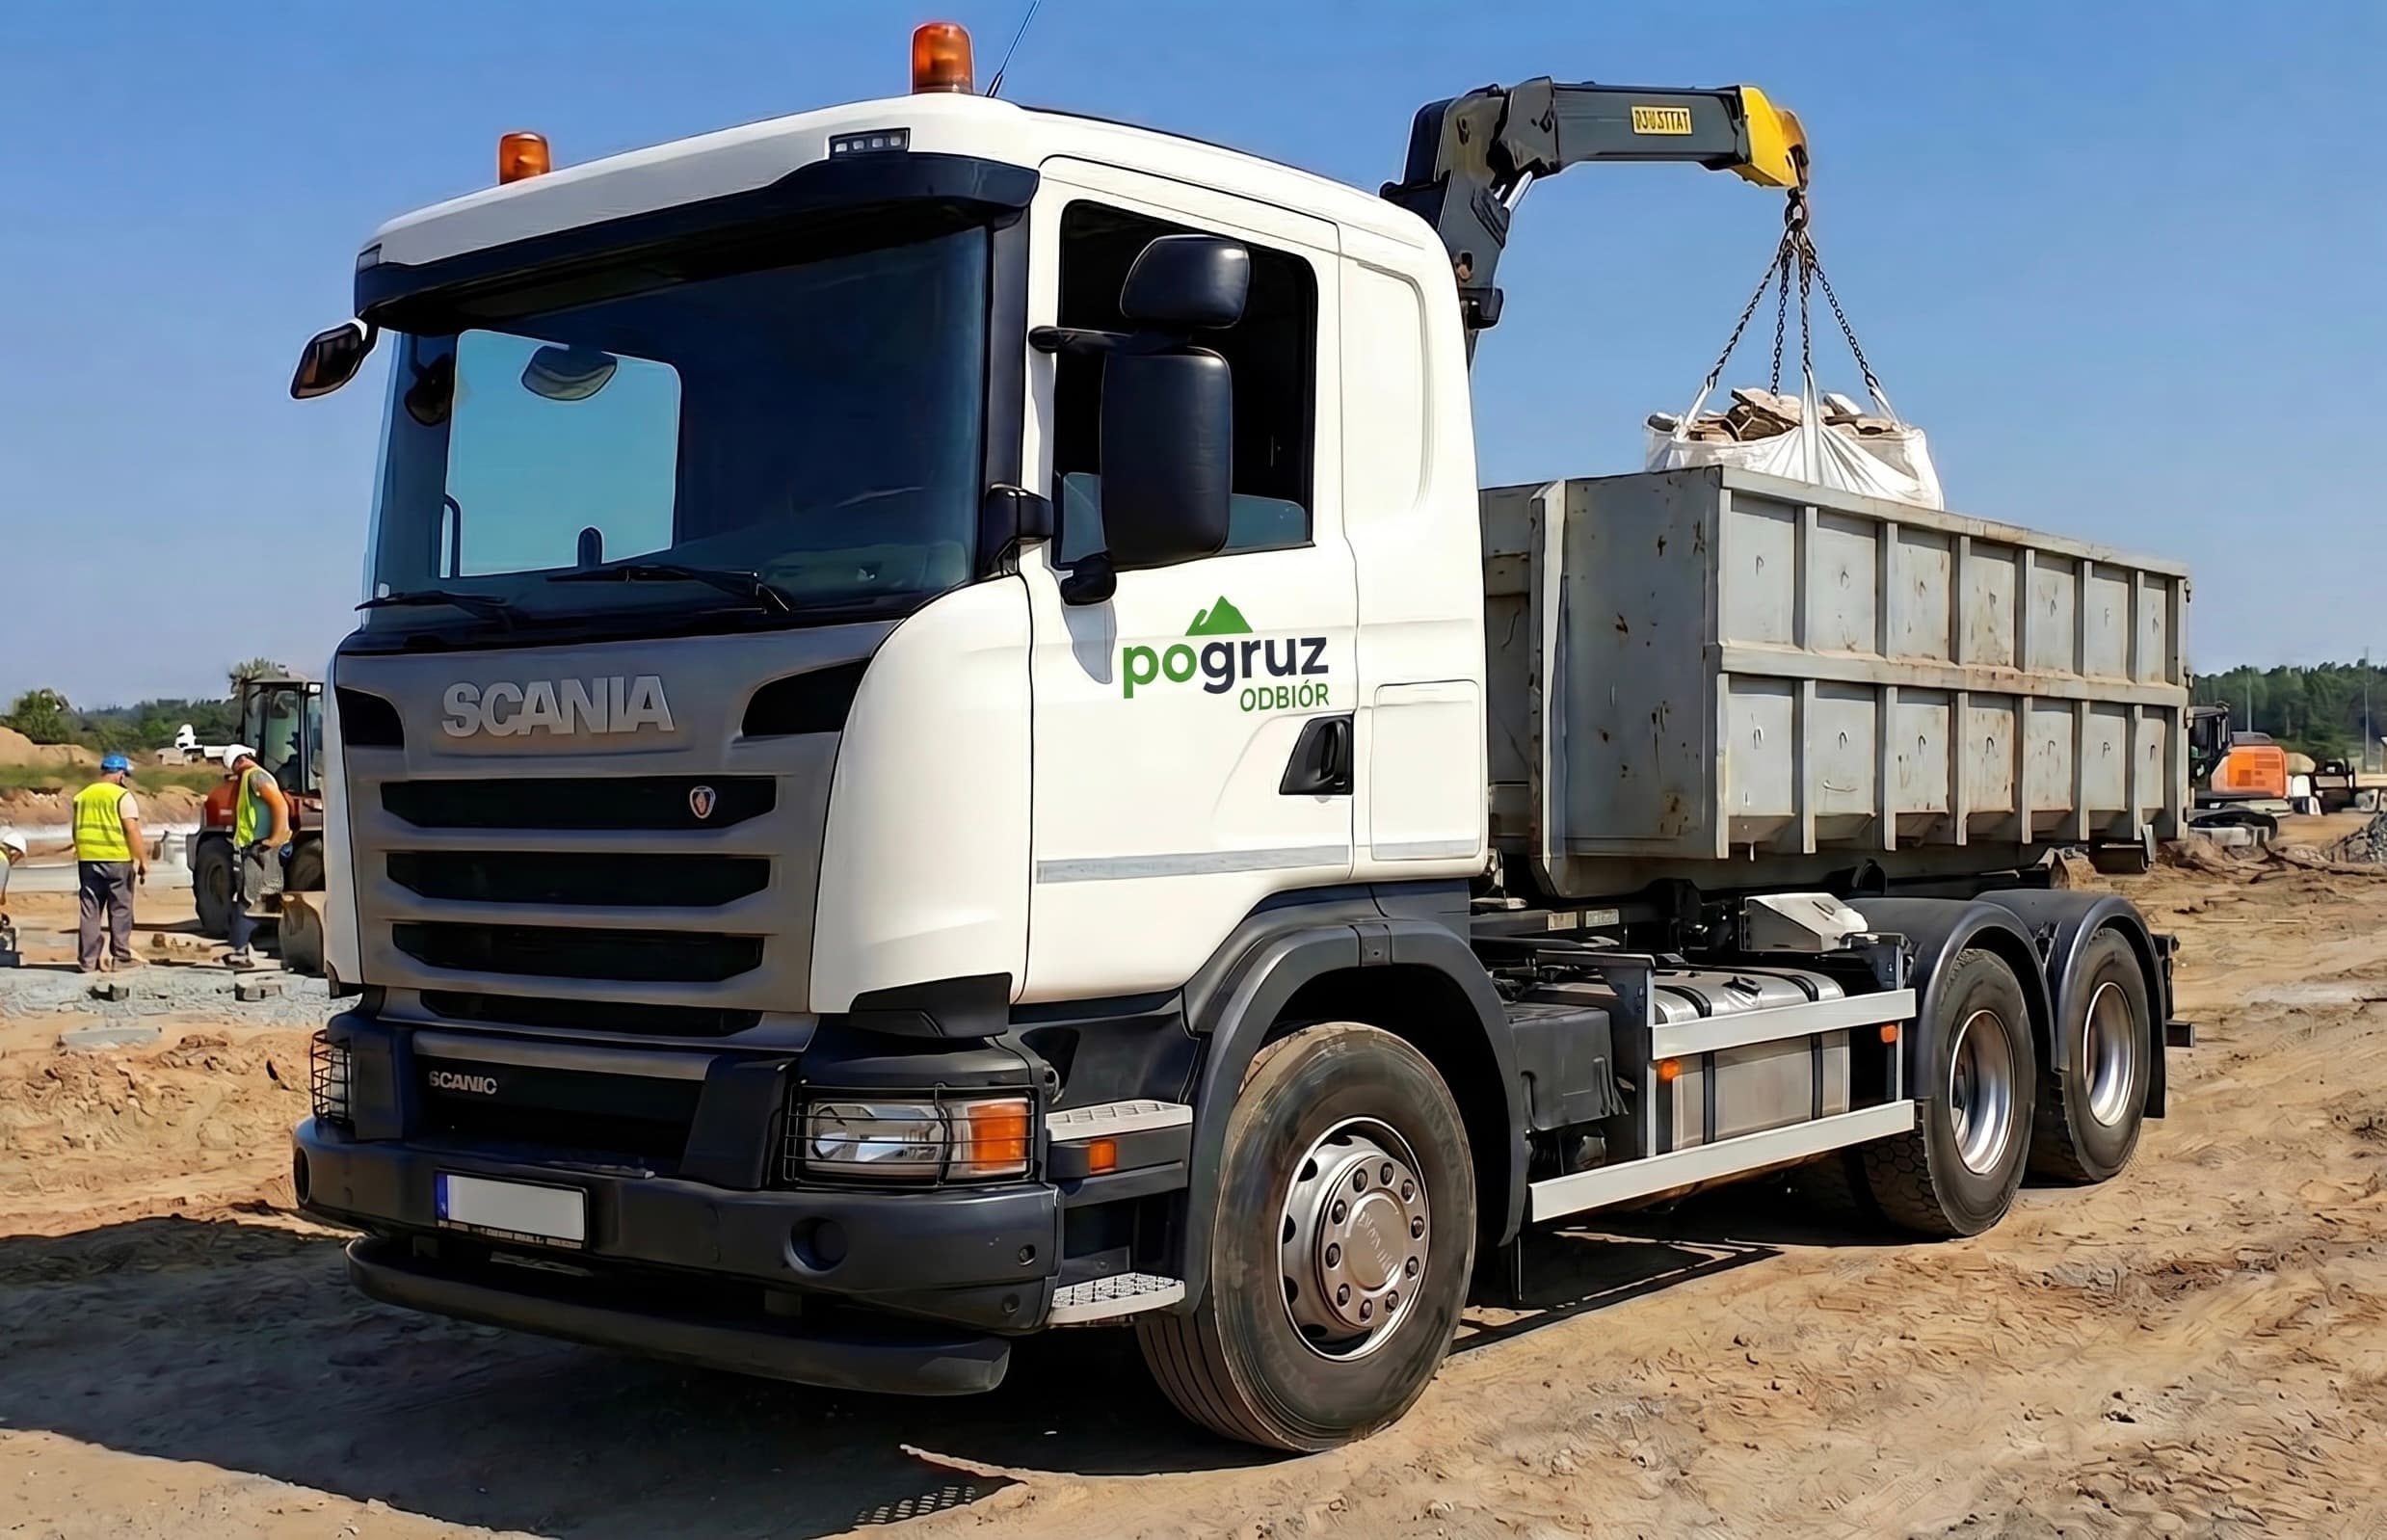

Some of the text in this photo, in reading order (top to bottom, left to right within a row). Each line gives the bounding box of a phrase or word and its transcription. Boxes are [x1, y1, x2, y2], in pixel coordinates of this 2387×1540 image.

[1123, 637, 1329, 699] pogruz
[1239, 679, 1330, 712] ODBIÓR
[441, 675, 675, 737] SCANIA
